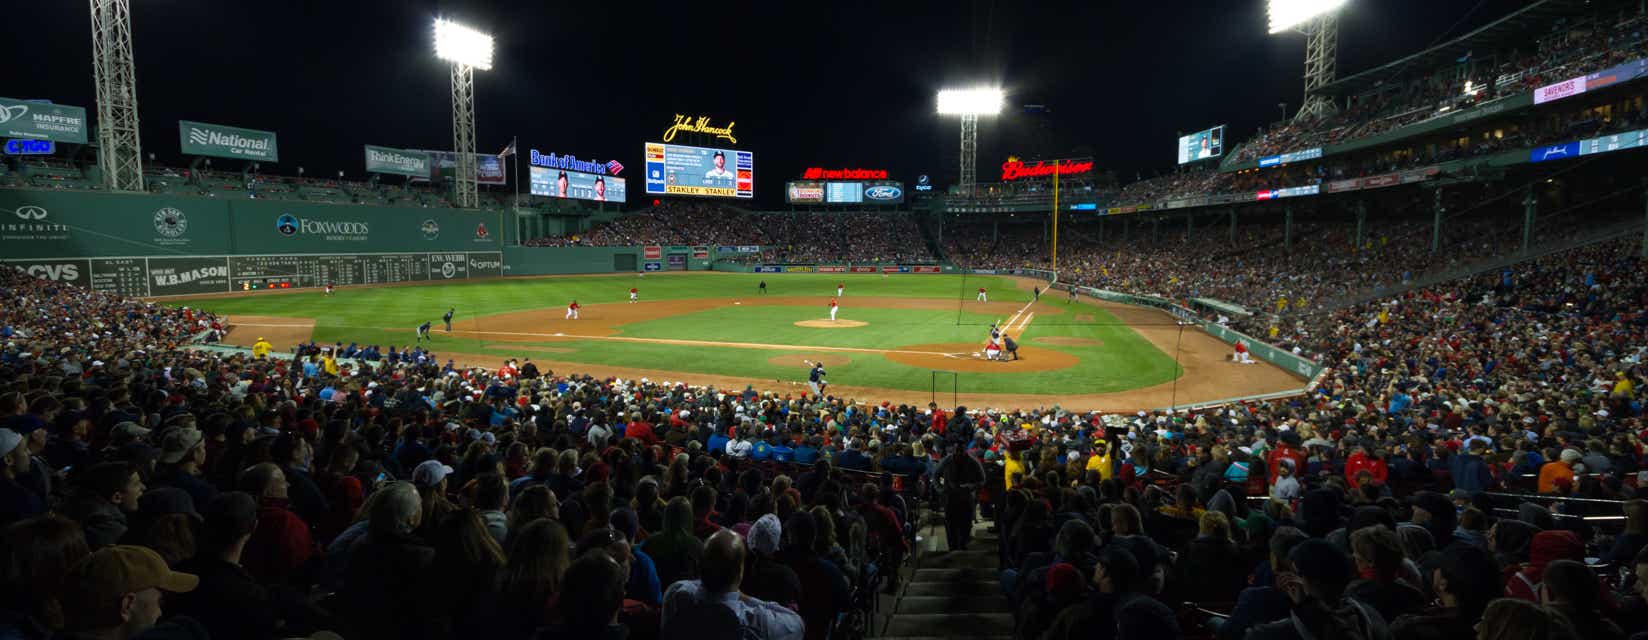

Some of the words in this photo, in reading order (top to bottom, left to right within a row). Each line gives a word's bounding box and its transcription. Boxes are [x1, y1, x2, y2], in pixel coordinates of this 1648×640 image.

[33, 114, 81, 125] MAPFRE
[664, 114, 694, 142] John
[694, 116, 737, 144] Hancock
[530, 149, 559, 168] Bank
[560, 155, 570, 169] of
[569, 156, 606, 174] America
[822, 169, 843, 178] new
[844, 168, 887, 179] balance
[1001, 160, 1094, 180] Budweiser
[871, 188, 896, 198] Ford
[301, 218, 369, 234] FOXWOODS
[28, 263, 79, 280] CVS
